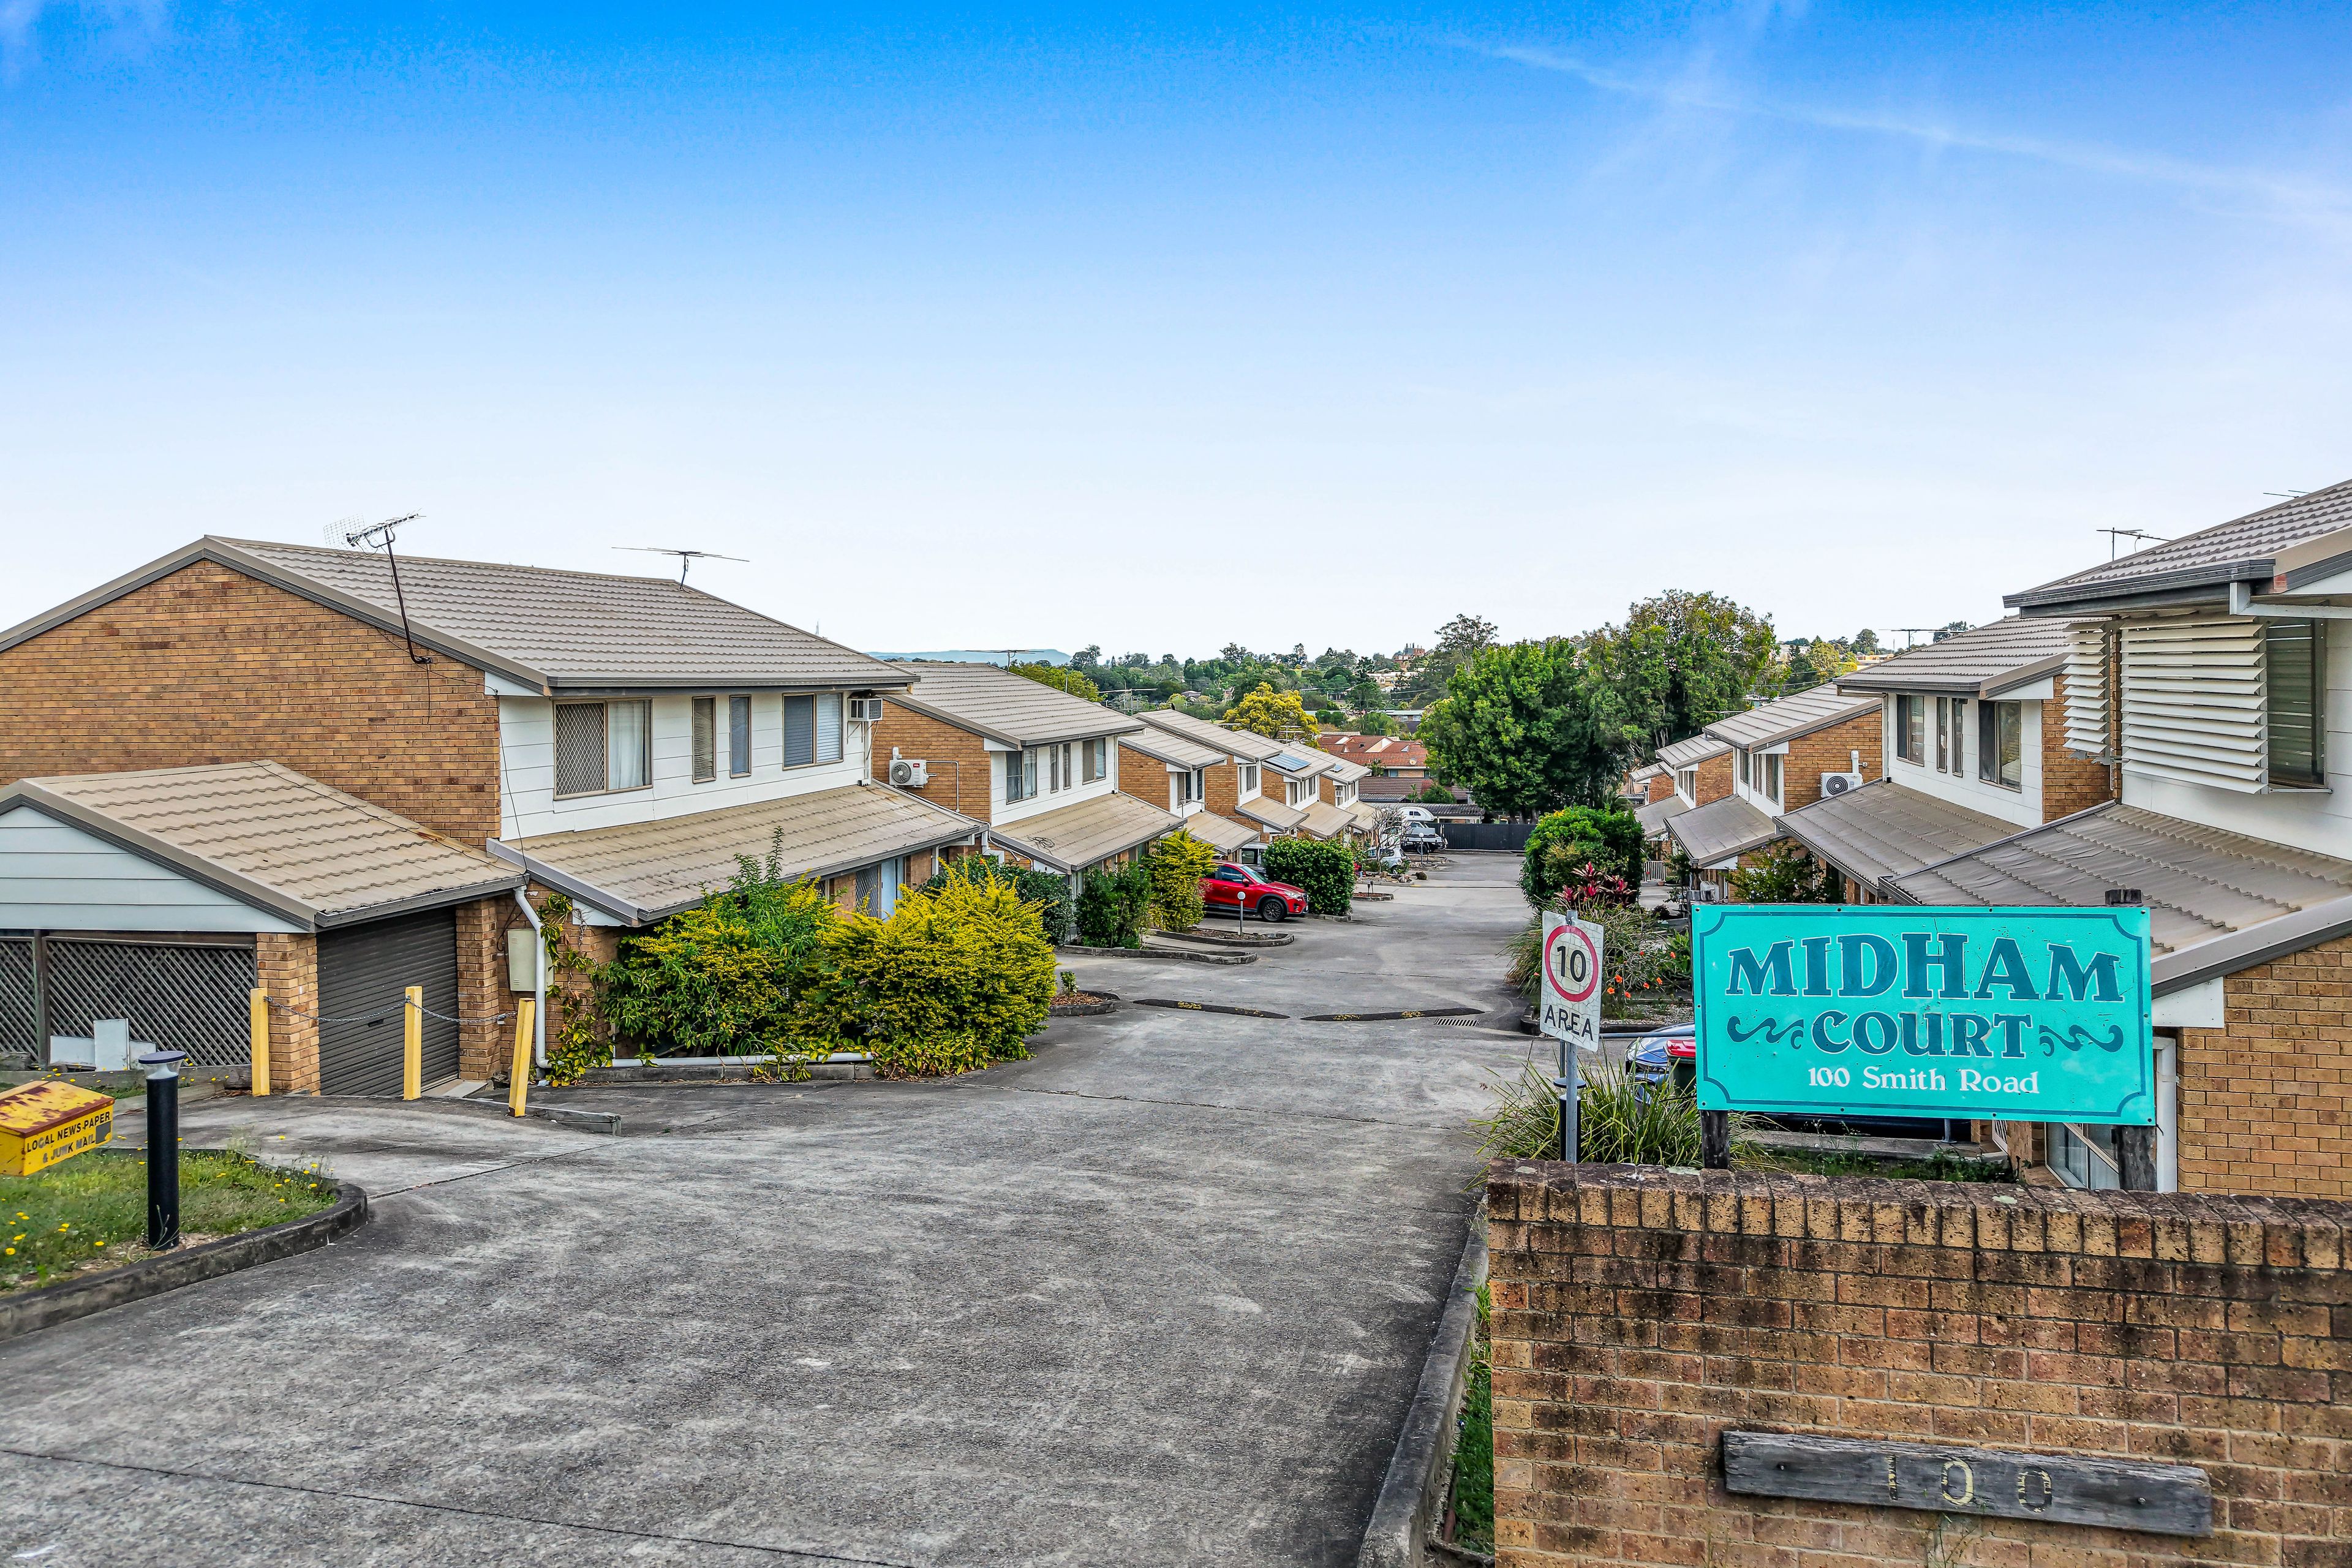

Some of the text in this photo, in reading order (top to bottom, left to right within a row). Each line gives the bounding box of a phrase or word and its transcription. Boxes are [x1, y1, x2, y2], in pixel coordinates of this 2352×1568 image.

[1556, 946, 1586, 982] 10
[1725, 932, 2125, 1003] MIDHAM
[1544, 1005, 1594, 1041] AREA
[1812, 1010, 2033, 1058] COURT
[1808, 1066, 2040, 1093] 100 Smith Road
[27, 1134, 55, 1152] LOCAL
